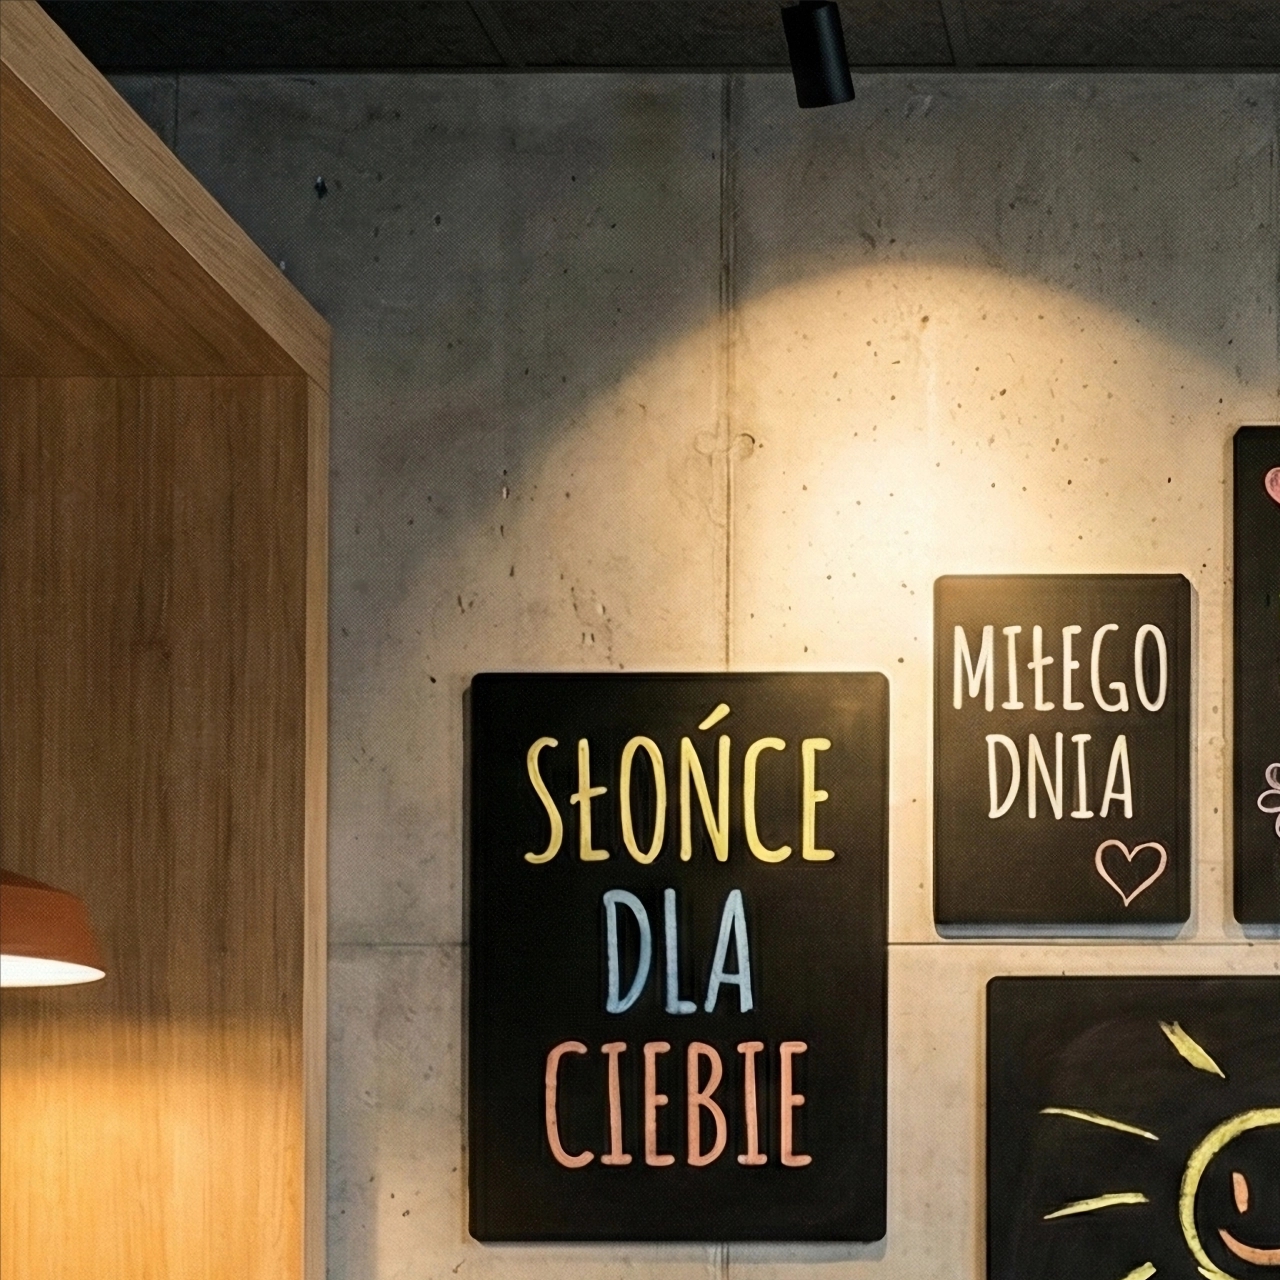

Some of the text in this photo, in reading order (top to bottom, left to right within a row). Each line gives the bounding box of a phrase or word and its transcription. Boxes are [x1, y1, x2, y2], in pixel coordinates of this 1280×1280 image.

[952, 622, 1167, 713] MIŁEGO
[525, 703, 836, 864] SŁOŃCE
[985, 731, 1133, 820] DNIA
[603, 888, 753, 1014] DLA
[545, 1040, 813, 1169] CIEBIE
